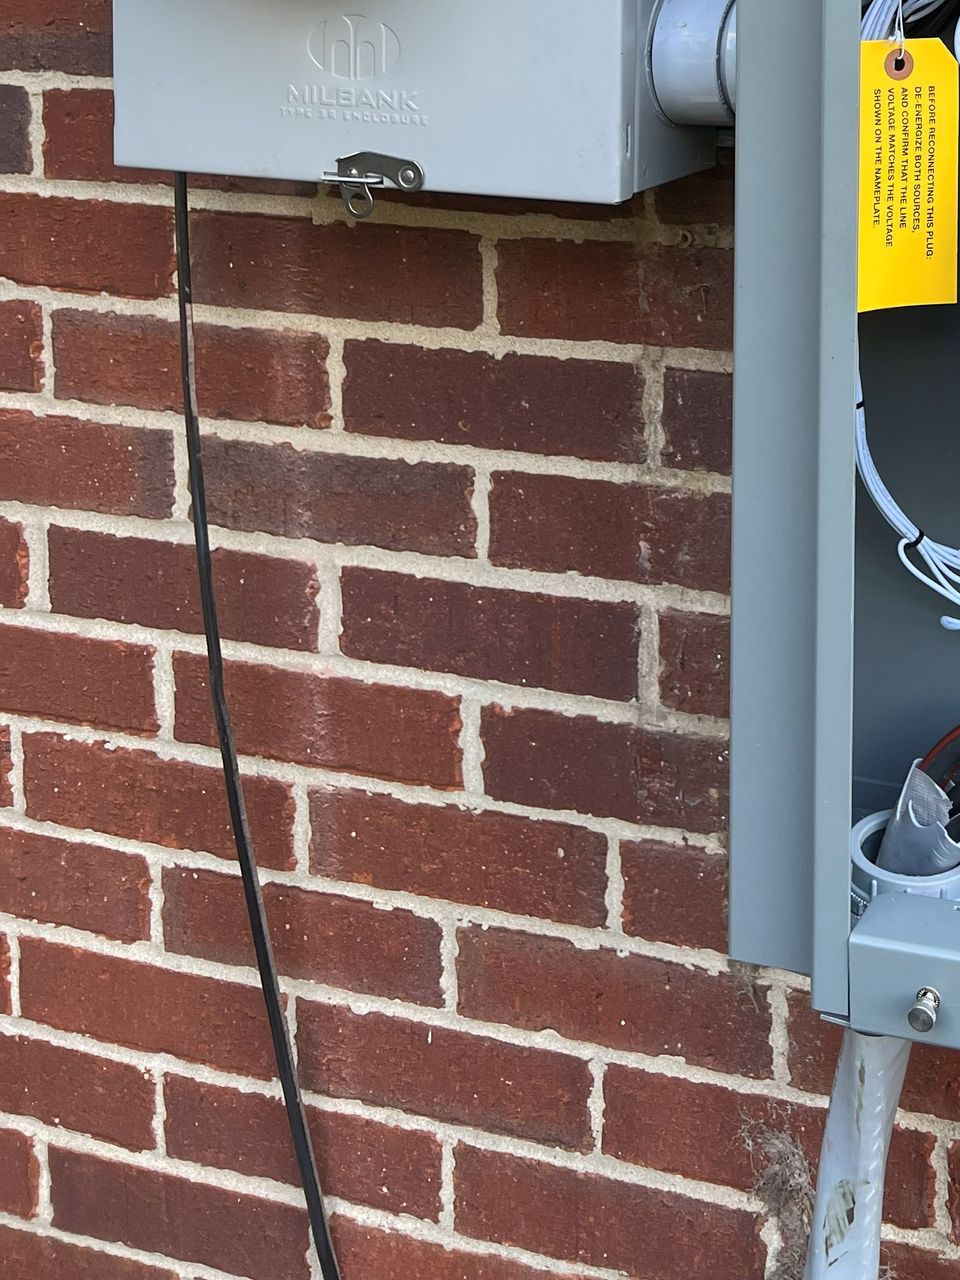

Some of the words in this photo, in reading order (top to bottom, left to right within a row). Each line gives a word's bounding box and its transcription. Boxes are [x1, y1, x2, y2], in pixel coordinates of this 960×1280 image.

[287, 83, 420, 112] MILBANK
[873, 88, 882, 126] SHOWN
[887, 87, 896, 132] VOLTAGE
[927, 85, 936, 125] BEFORE
[280, 106, 313, 119] TYPE
[342, 110, 430, 127] ENCLOSURE
[914, 86, 923, 152] DE-ENERGIZE
[874, 128, 882, 143] ON
[901, 110, 909, 156] CONFIRM
[874, 145, 882, 165] THE
[887, 134, 896, 181] MATCHES
[914, 154, 922, 181] BOTH
[926, 127, 936, 205] RECONNECTING
[900, 158, 909, 183] THAT
[886, 183, 895, 202] THE
[899, 186, 908, 204] THE
[899, 207, 907, 229] LINE
[911, 183, 921, 233] SOURCES,
[926, 206, 935, 229] THIS
[885, 204, 894, 248] VOLTAGE
